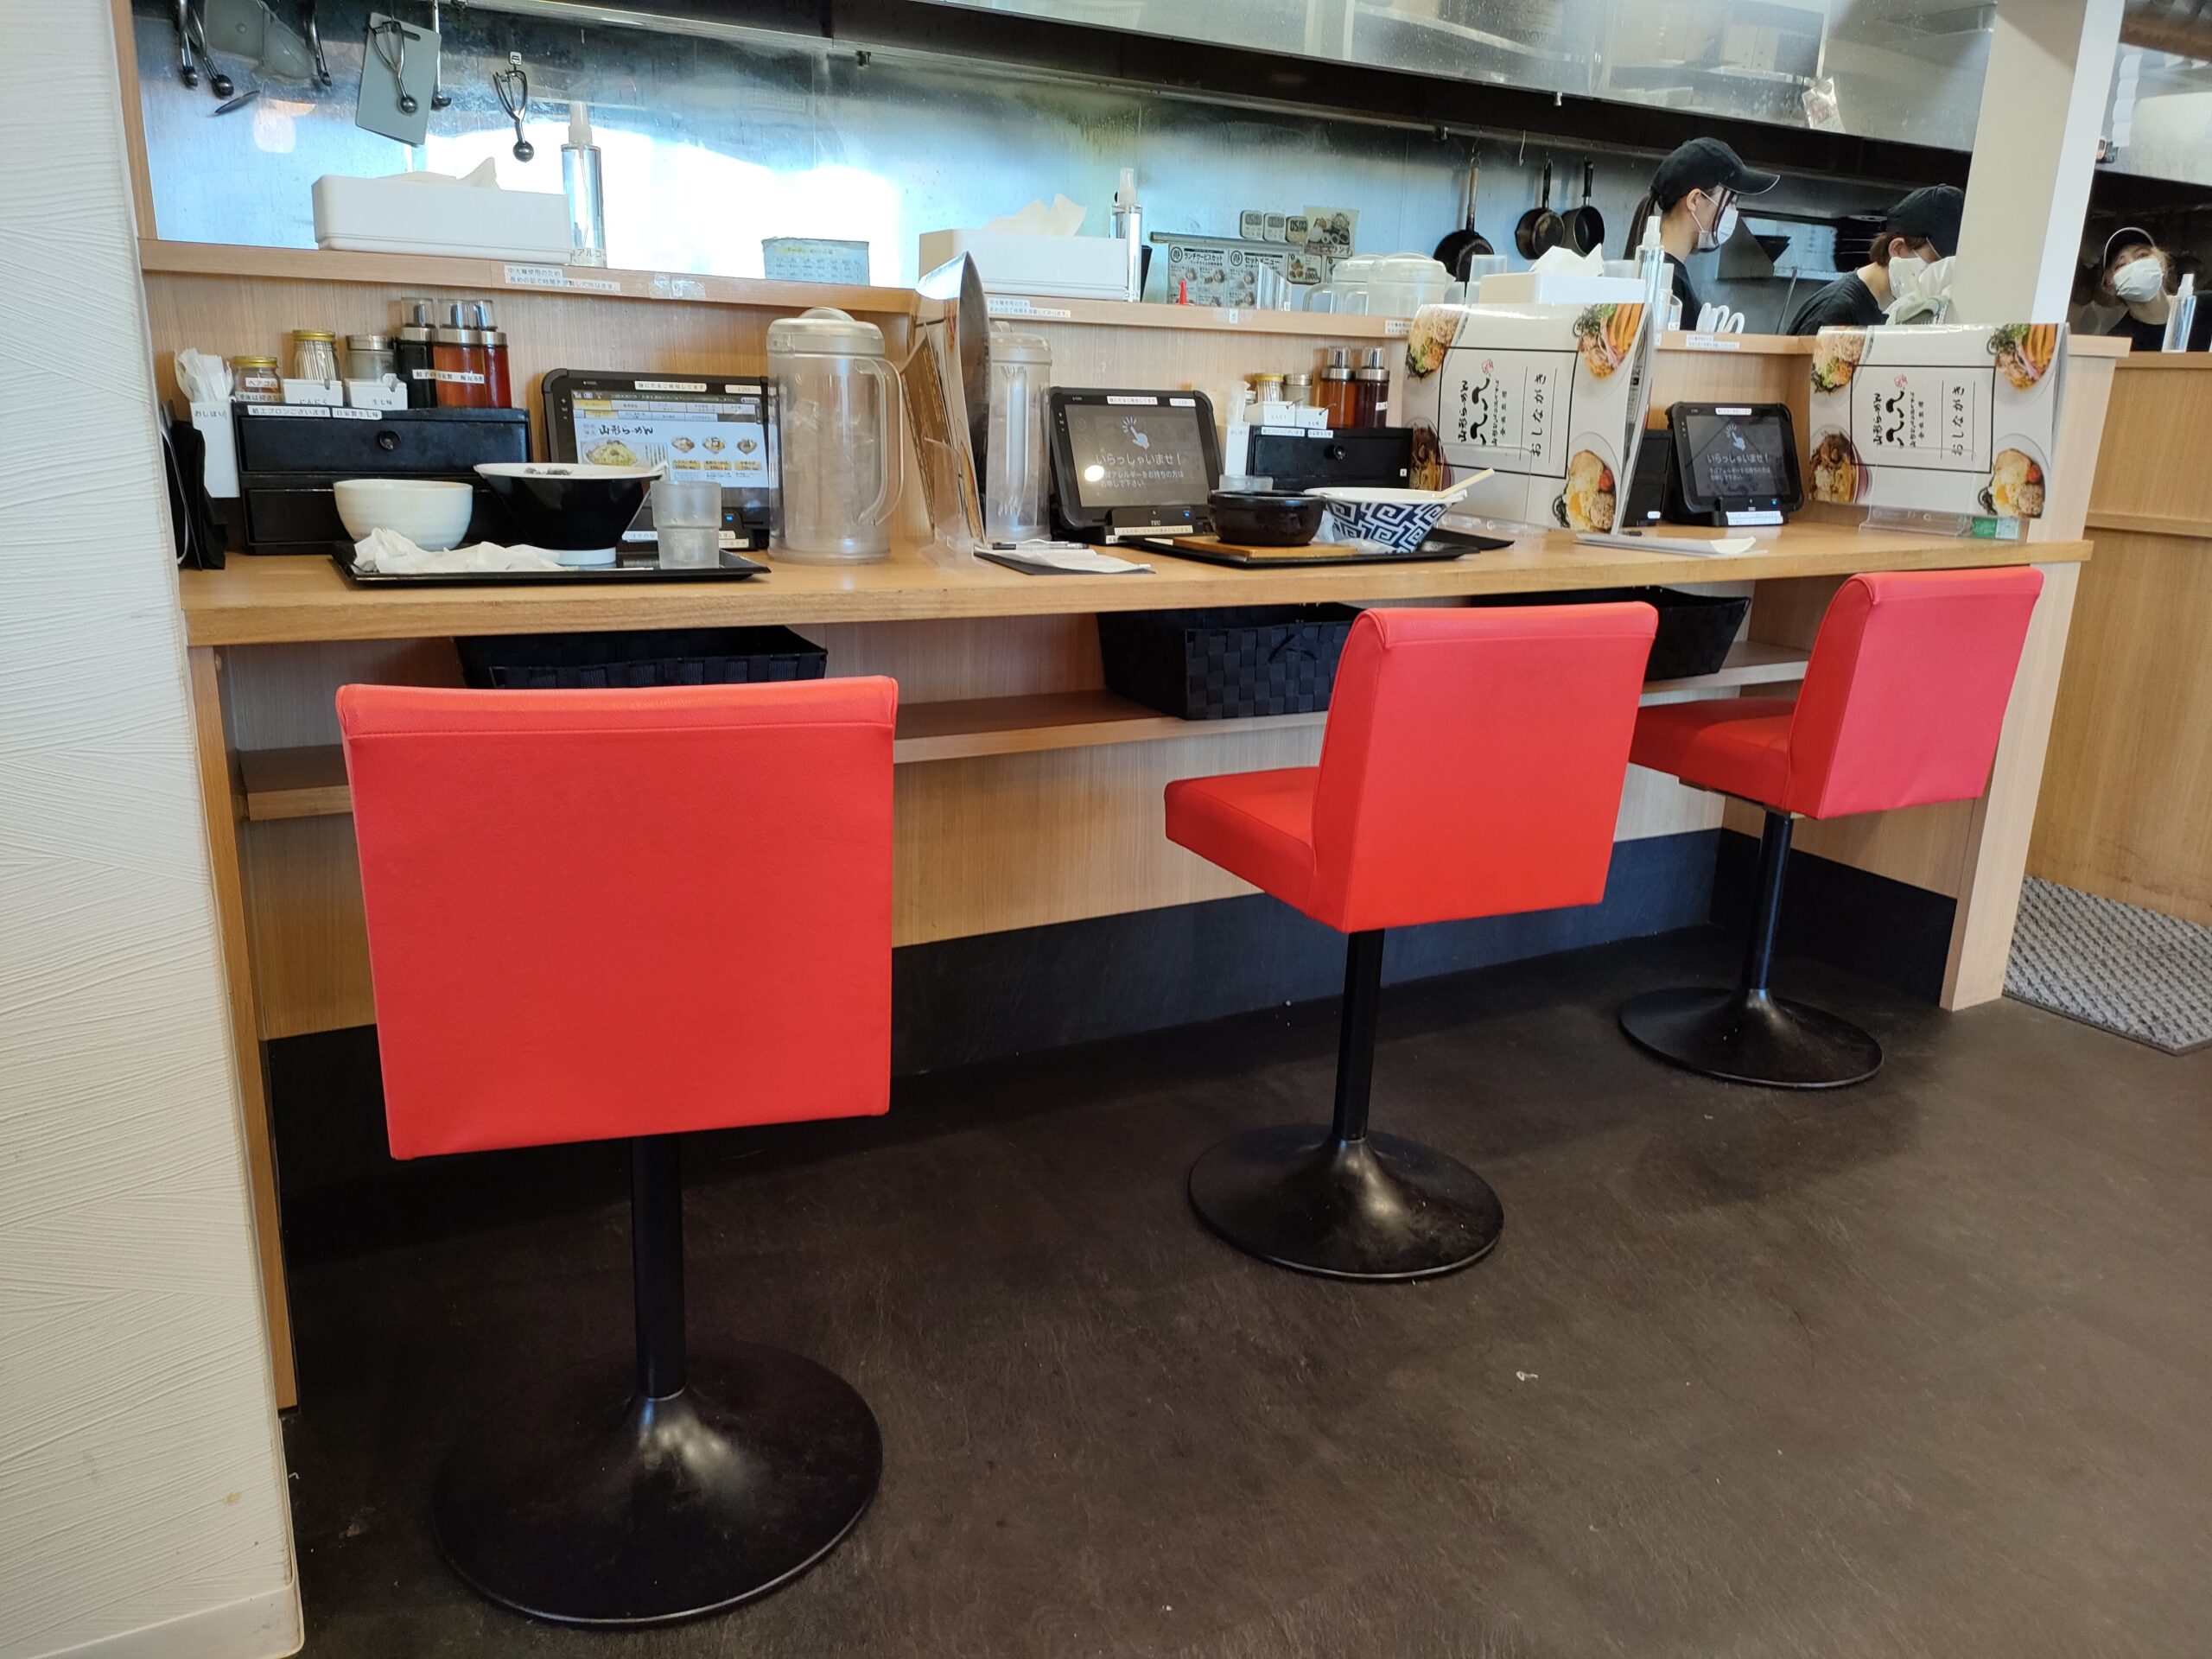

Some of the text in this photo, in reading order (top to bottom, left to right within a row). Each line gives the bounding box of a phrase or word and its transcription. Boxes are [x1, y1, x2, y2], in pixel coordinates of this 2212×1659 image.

[251, 407, 327, 416] 紙エプロンございます
[1531, 373, 1547, 457] おしながき
[1952, 385, 1965, 456] おしながき
[1102, 469, 1185, 480] ばアレルギーをお持ちの方は
